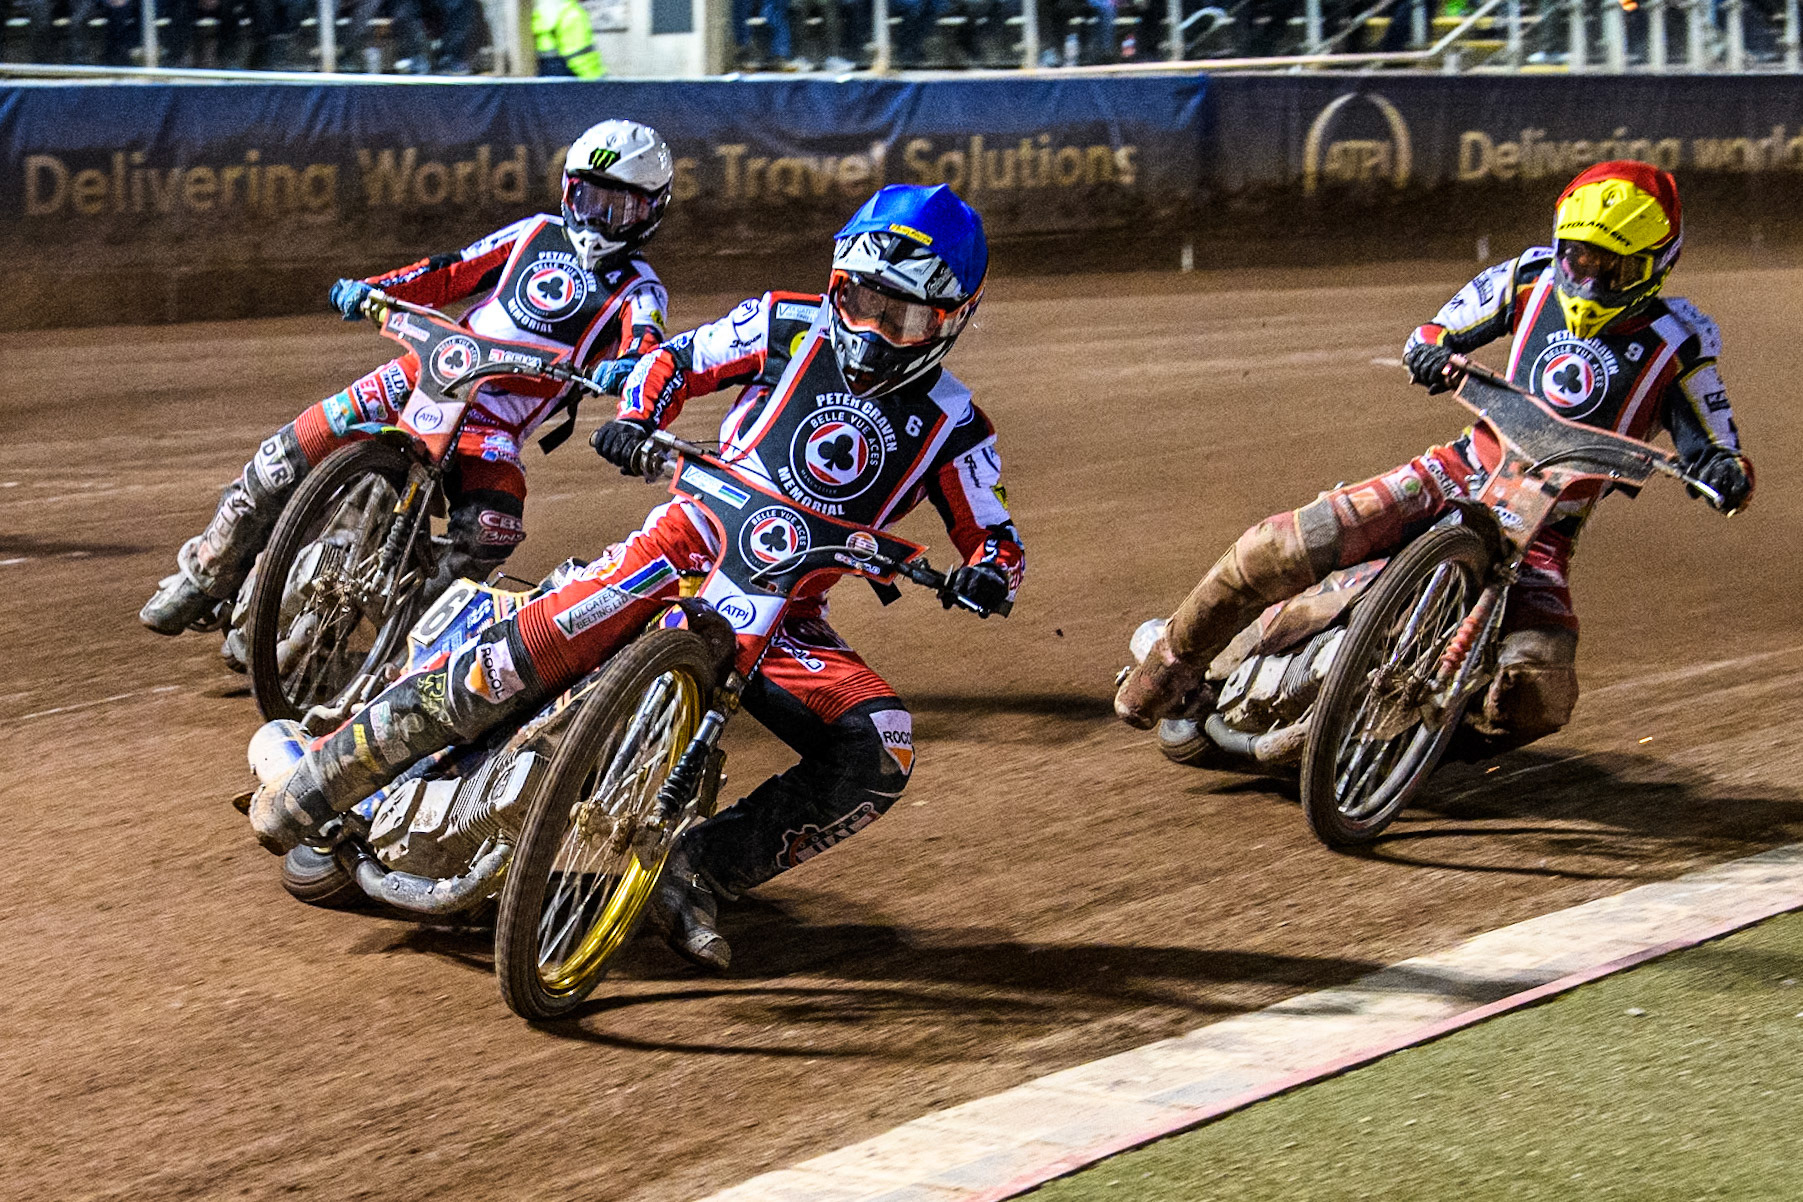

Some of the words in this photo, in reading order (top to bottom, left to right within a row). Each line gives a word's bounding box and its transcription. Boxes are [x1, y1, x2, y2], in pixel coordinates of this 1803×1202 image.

[23, 148, 338, 221] Delivering
[357, 145, 528, 206] World
[716, 141, 885, 200] Travel
[905, 134, 1137, 199] Solutions
[605, 270, 622, 285] 4
[508, 297, 552, 333] MEMORIAL
[1543, 344, 1571, 362] BELLE
[1575, 346, 1593, 361] VUE
[1592, 363, 1604, 388] ACES
[810, 411, 845, 428] BELLE
[850, 414, 871, 434] VUE
[868, 437, 879, 466] ACES
[816, 392, 861, 408] PETER
[862, 400, 897, 452] CRAVEN
[905, 415, 923, 437] 6
[262, 442, 288, 486] DVR
[777, 465, 845, 516] MEMORIAL
[751, 510, 777, 526] BELLE
[780, 511, 797, 524] VUE
[796, 525, 807, 546] ACES
[420, 588, 469, 636] 6
[576, 605, 613, 629] BELTING
[612, 595, 629, 609] LTD
[480, 647, 505, 699] ROCOL
